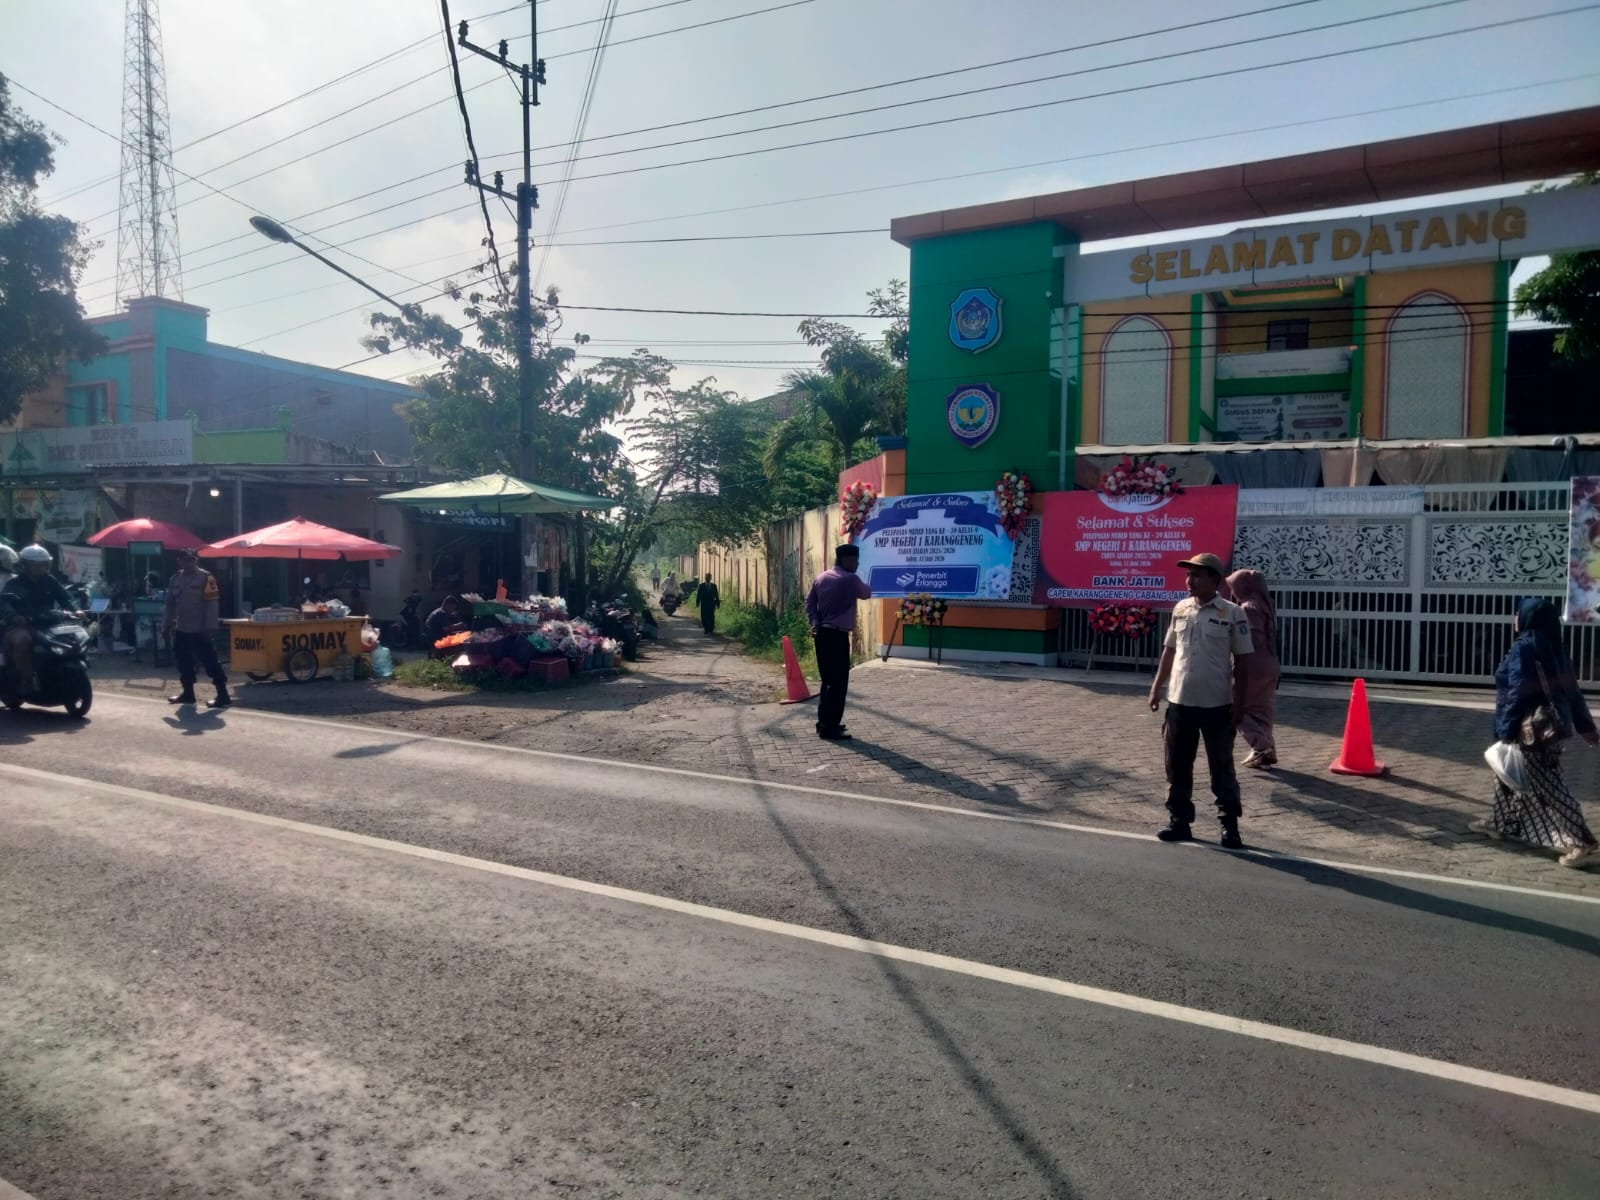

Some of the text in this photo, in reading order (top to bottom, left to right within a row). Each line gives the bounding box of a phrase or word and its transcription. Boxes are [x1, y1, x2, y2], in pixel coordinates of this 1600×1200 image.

[1129, 206, 1527, 284] SELAMAT DATANG
[1076, 512, 1194, 530] Selamat & Sukses
[874, 534, 984, 548] SMP NEGERI 1 KARANGGENENG
[1074, 540, 1192, 552] SMP NEGERI 1 KARANGGENENG
[916, 571, 947, 580] Penerbit
[1092, 576, 1166, 588] BANK JATIM
[915, 579, 948, 588] Erlangga
[1047, 588, 1073, 598] CAPEM
[1073, 589, 1133, 600] KARANGGENENG
[1135, 590, 1168, 601] CABANG
[281, 631, 347, 653] SIOMAY
